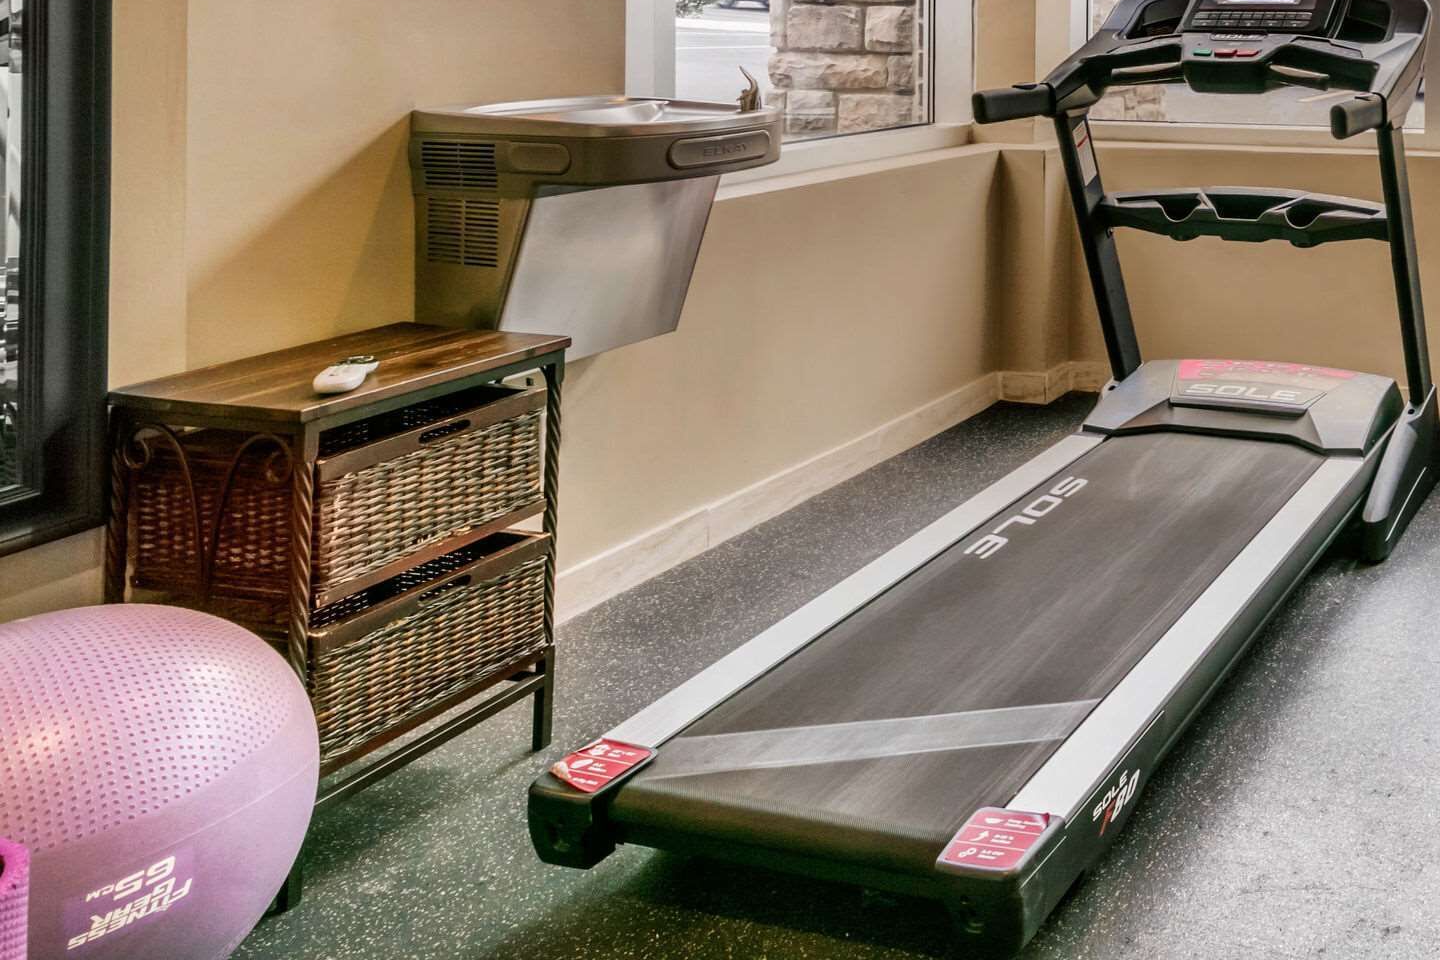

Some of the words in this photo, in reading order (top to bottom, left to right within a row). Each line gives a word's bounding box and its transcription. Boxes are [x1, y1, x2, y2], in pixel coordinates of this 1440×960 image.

[1184, 382, 1302, 401] SOLE
[963, 475, 1089, 559] SOLE
[1092, 769, 1128, 822] SOLE
[66, 878, 192, 950] FITNESS
[90, 877, 176, 929] GEAR
